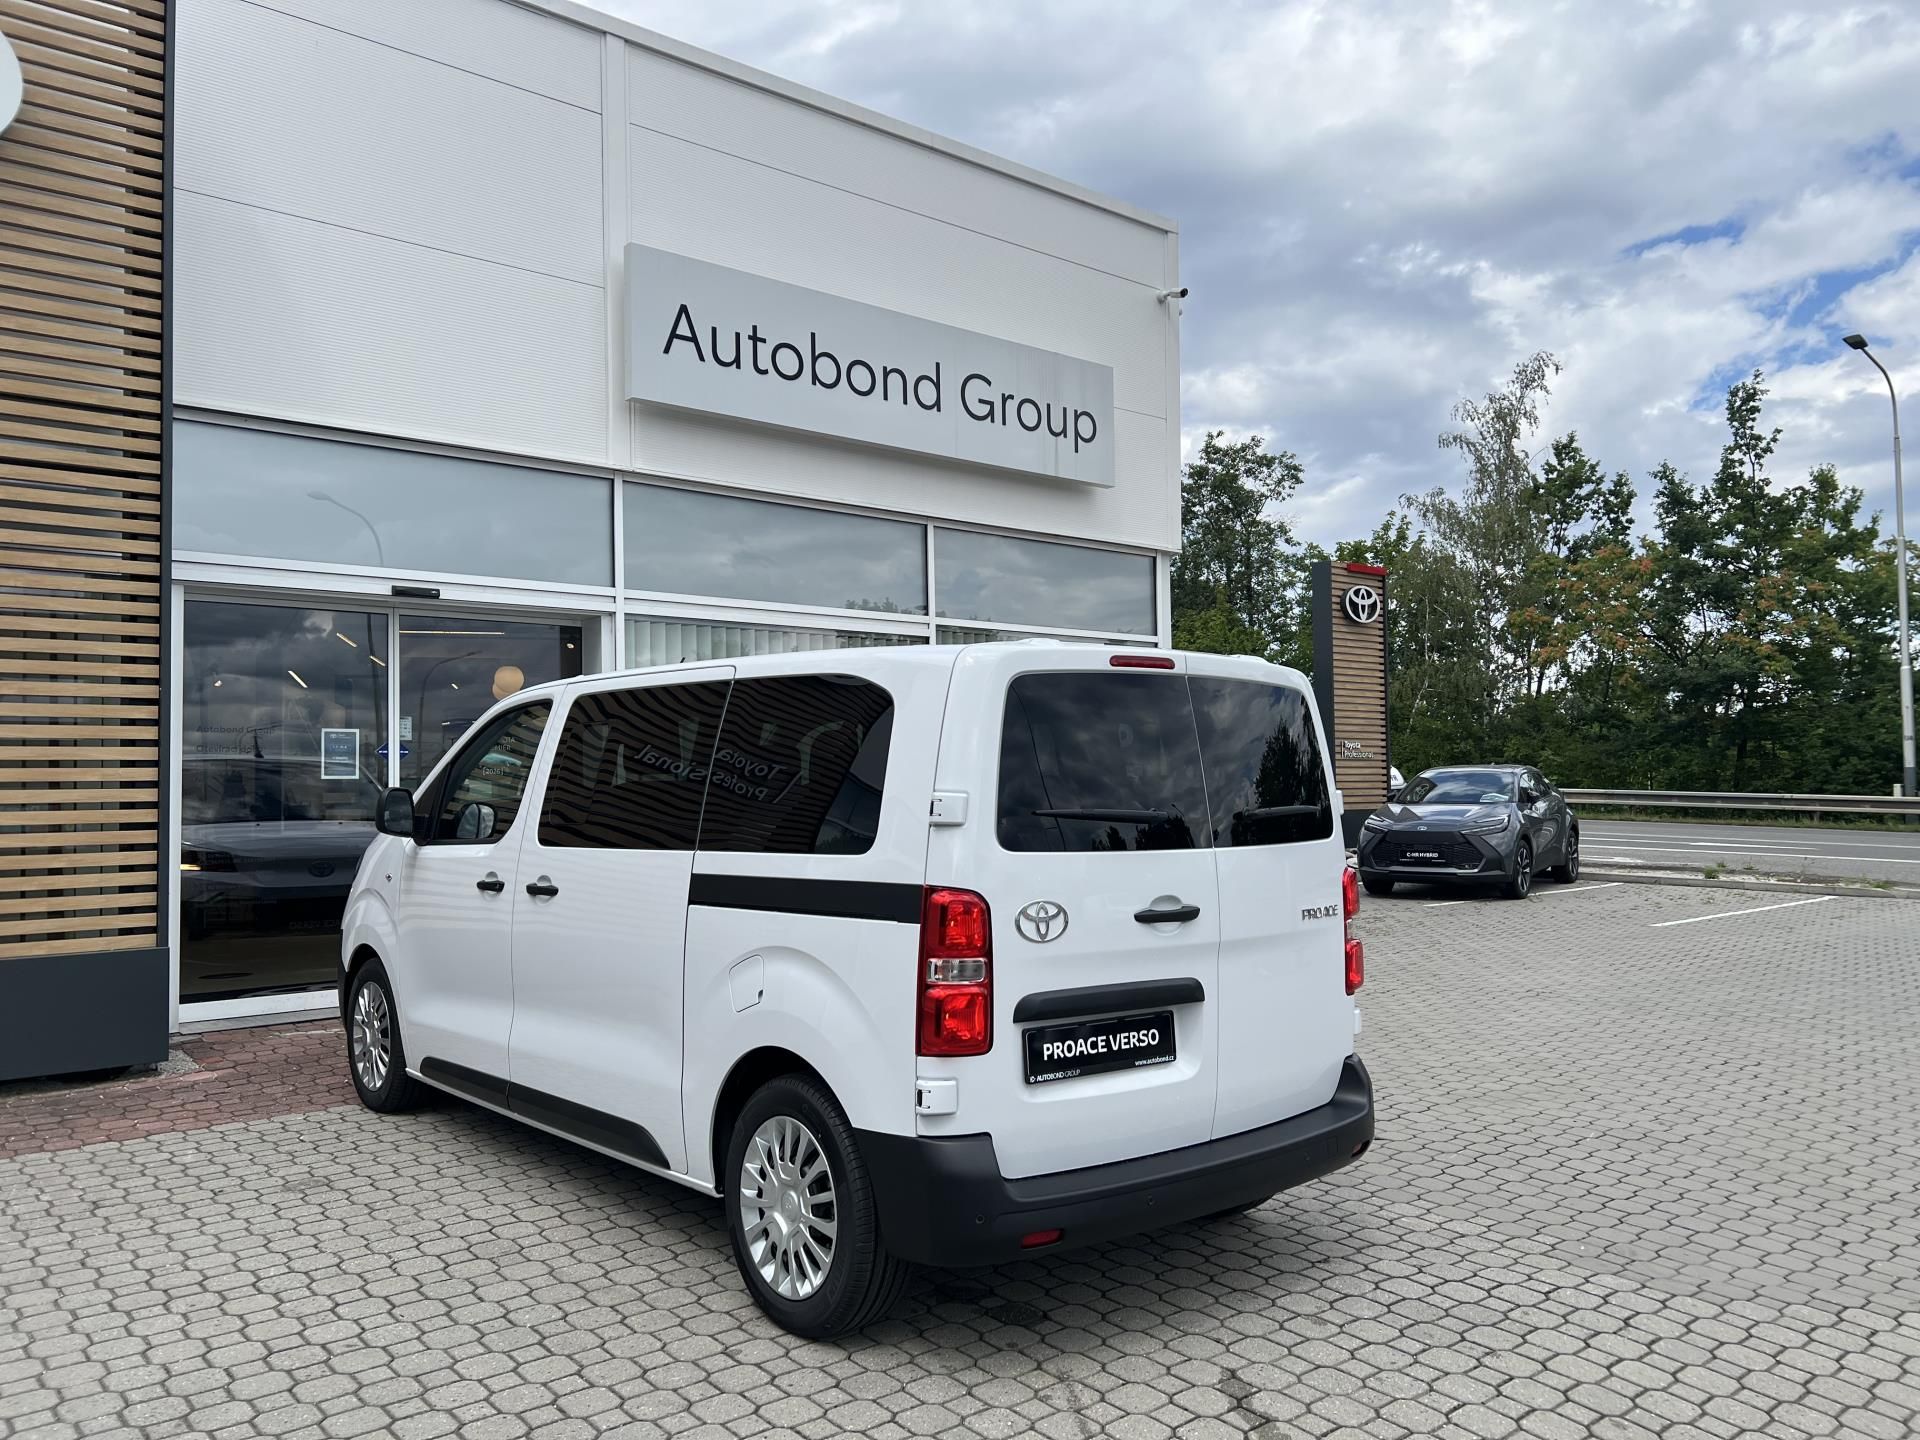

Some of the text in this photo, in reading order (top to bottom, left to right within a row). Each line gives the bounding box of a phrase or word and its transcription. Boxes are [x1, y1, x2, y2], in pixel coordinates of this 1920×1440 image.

[663, 303, 1097, 453] Autobond Group
[1344, 740, 1361, 750] Toyota
[1344, 750, 1374, 758] Professional
[1302, 904, 1338, 920] PROACE
[1043, 1029, 1159, 1061] PROACE VERSO
[1135, 1054, 1174, 1065] www.autobond.cz
[1036, 1069, 1081, 1082] AUTOBOND GROUP
